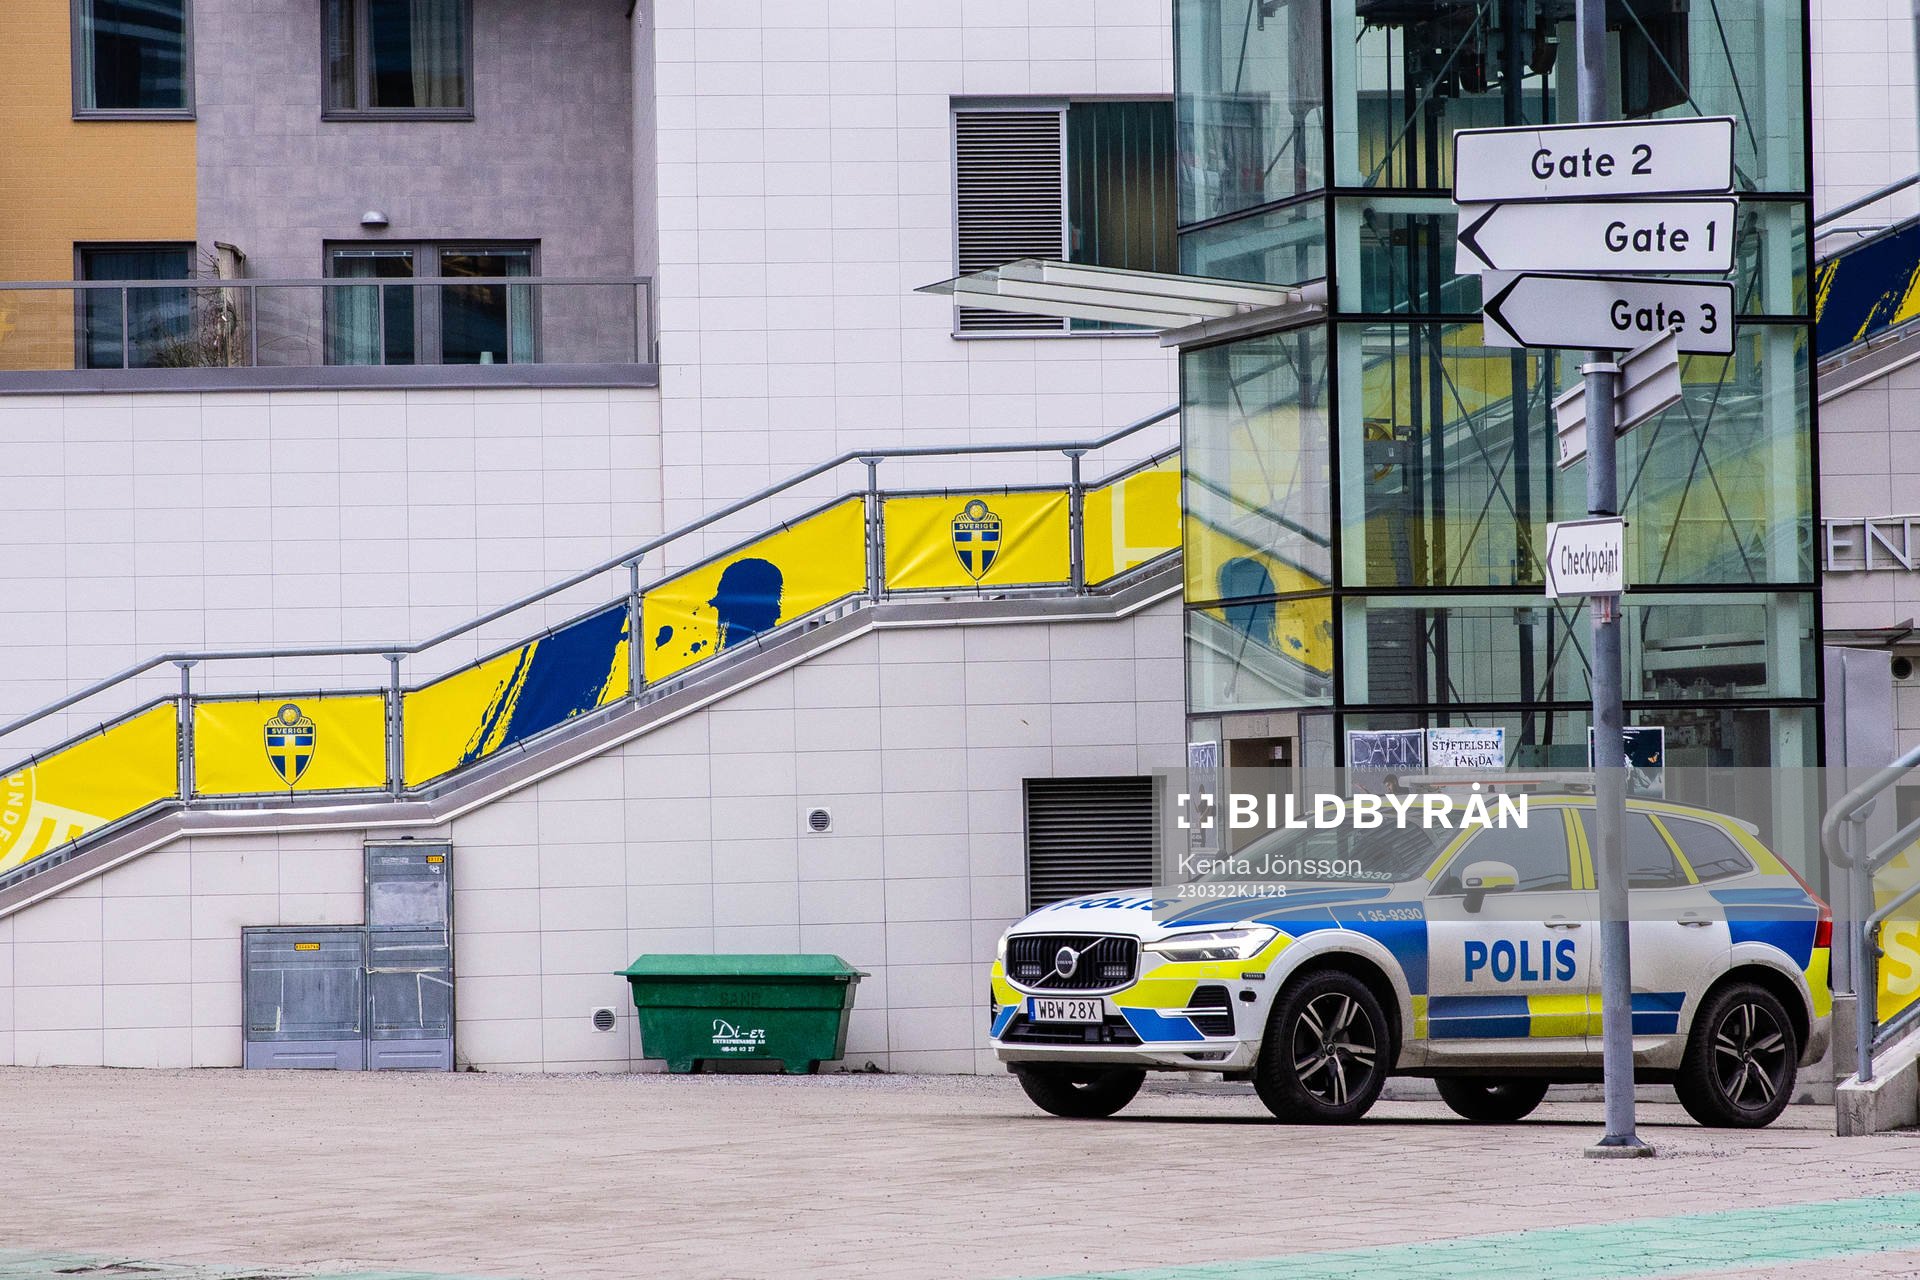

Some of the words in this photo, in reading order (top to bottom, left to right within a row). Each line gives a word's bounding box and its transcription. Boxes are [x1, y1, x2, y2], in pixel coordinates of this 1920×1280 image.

[1531, 147, 1616, 180] Gate
[1631, 143, 1652, 175] 2
[1604, 221, 1689, 252] Gate
[1706, 220, 1716, 253] 1
[1610, 299, 1686, 334] Gate
[1699, 303, 1717, 334] 3
[1560, 541, 1619, 582] Checkpoint
[1351, 735, 1422, 764] DARIN
[1050, 897, 1182, 911] POLIS
[1367, 908, 1423, 922] 35-9330
[1464, 938, 1577, 983] POLIS
[1038, 1001, 1064, 1019] WBW
[1068, 1001, 1097, 1020] 28X
